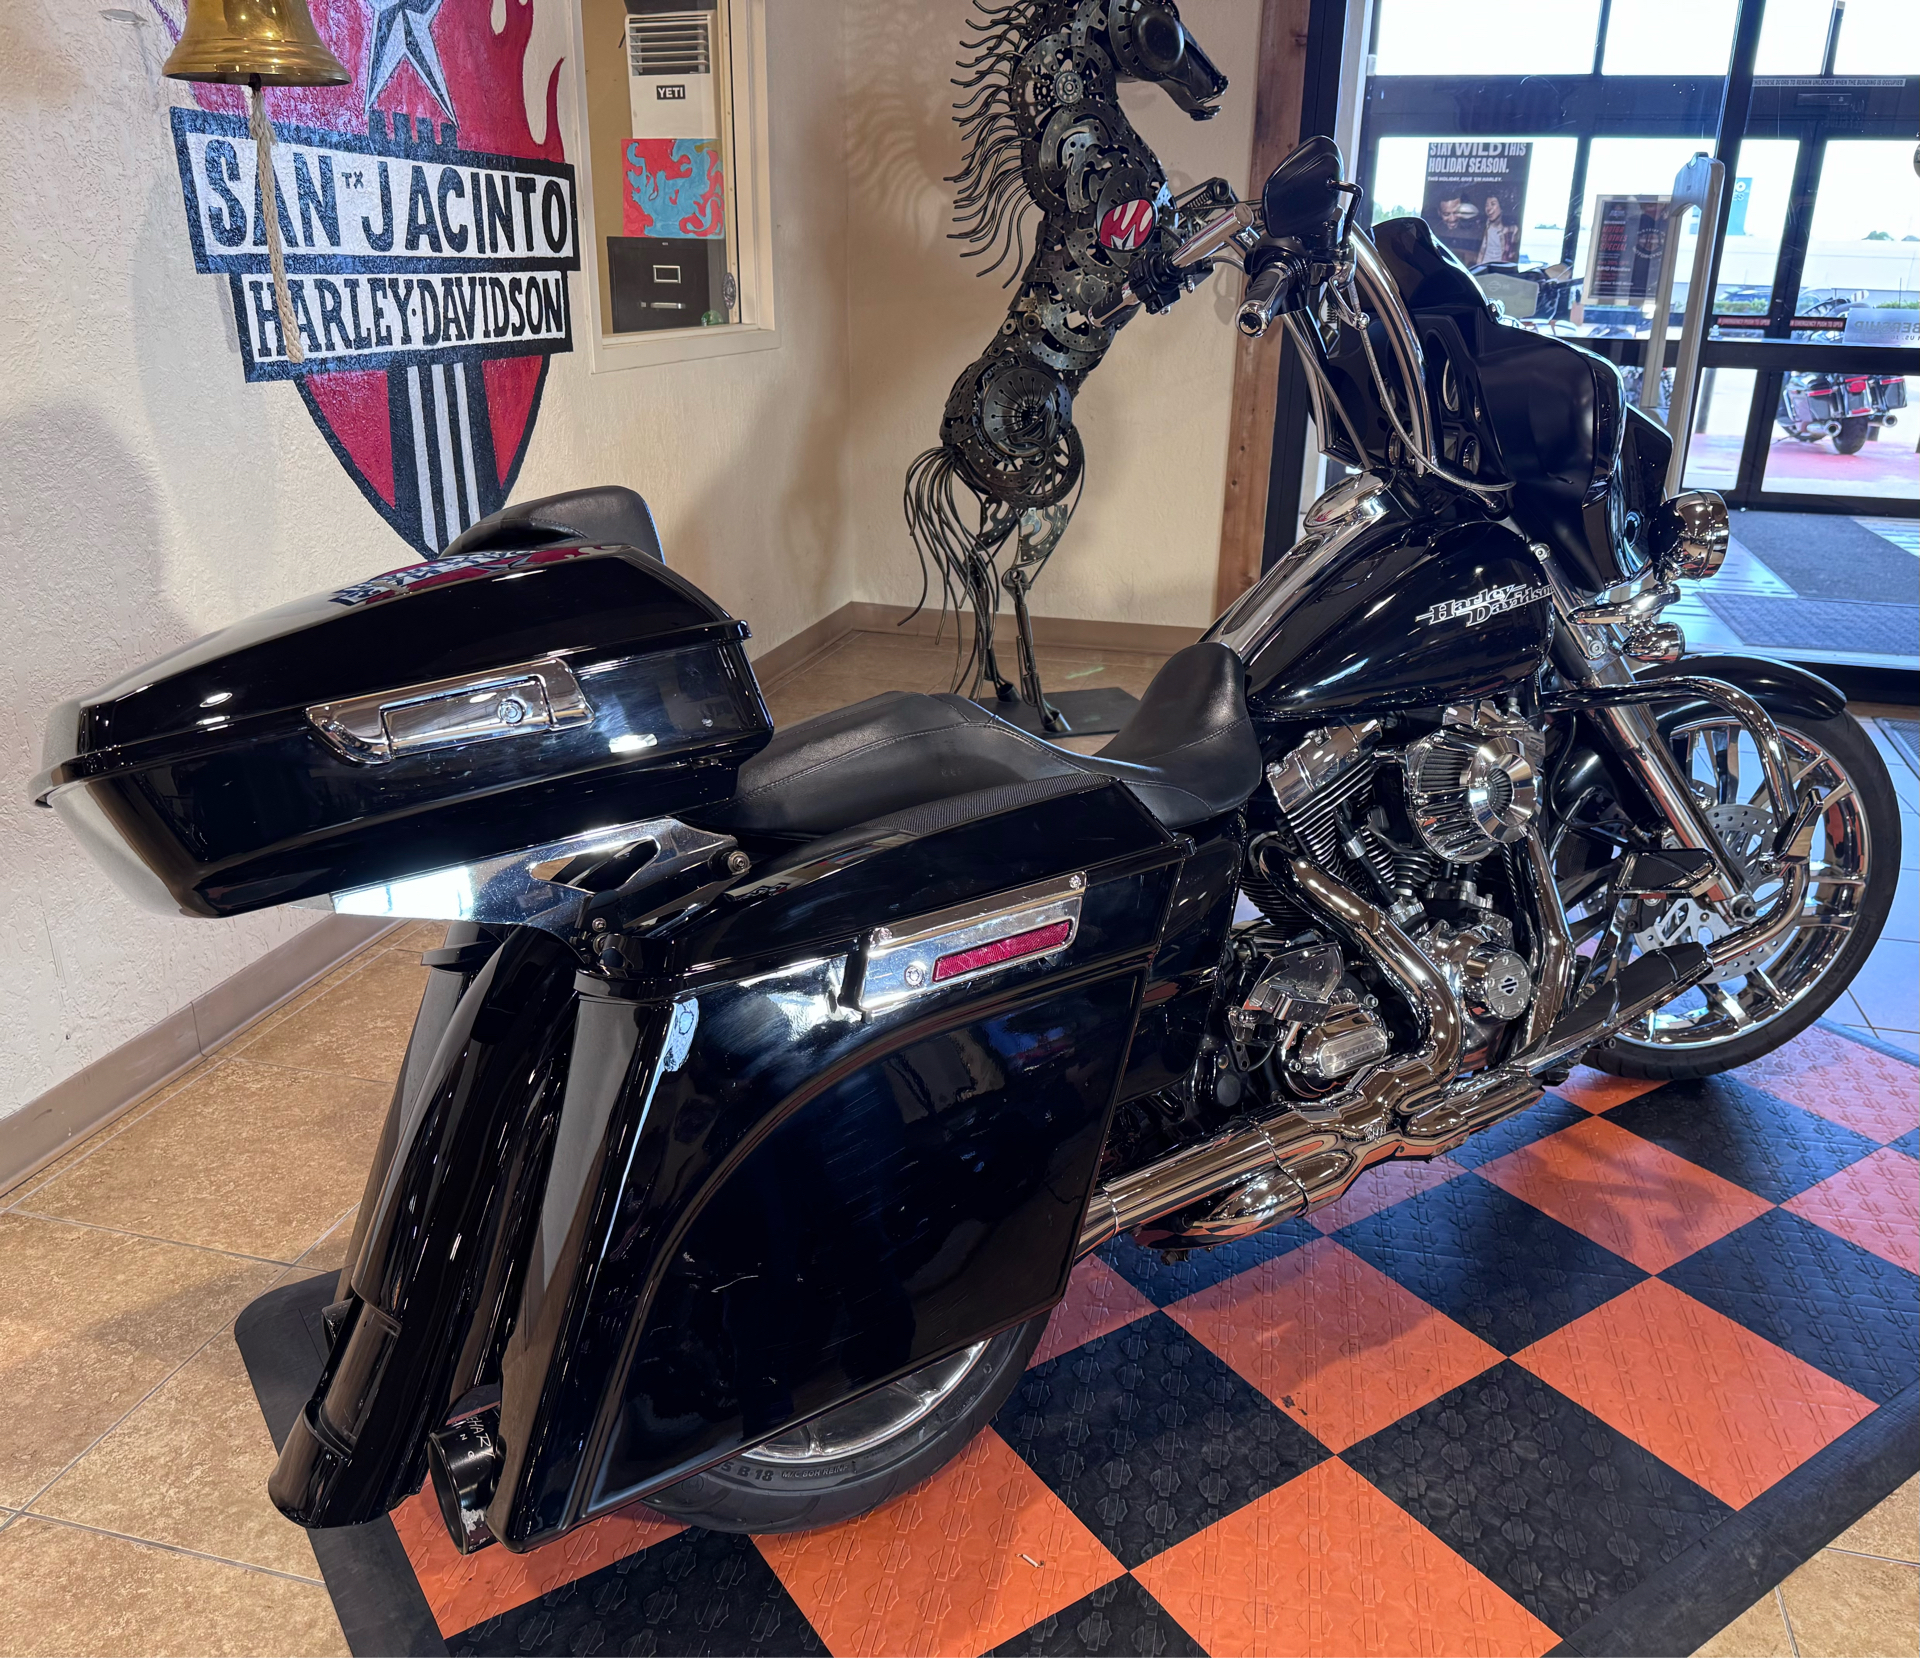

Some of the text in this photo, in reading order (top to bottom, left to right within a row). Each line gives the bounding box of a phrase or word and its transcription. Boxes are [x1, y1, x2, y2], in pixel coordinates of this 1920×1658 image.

[658, 87, 684, 98] YETI
[1430, 142, 1527, 156] STAY WILD THIS
[1428, 157, 1510, 173] HOLIDAY SEASON.
[204, 138, 569, 254] SAN TX JACINTO
[1602, 225, 1625, 233] MOTOR
[1601, 234, 1628, 242] CLOTHES
[1599, 243, 1627, 251] SPECIAL
[1424, 584, 1522, 625] Harley
[1465, 584, 1555, 628] Davidson
[736, 1465, 751, 1477] B
[754, 1468, 774, 1482] 18
[781, 1470, 800, 1479] M/C
[822, 1464, 849, 1476] REINF
